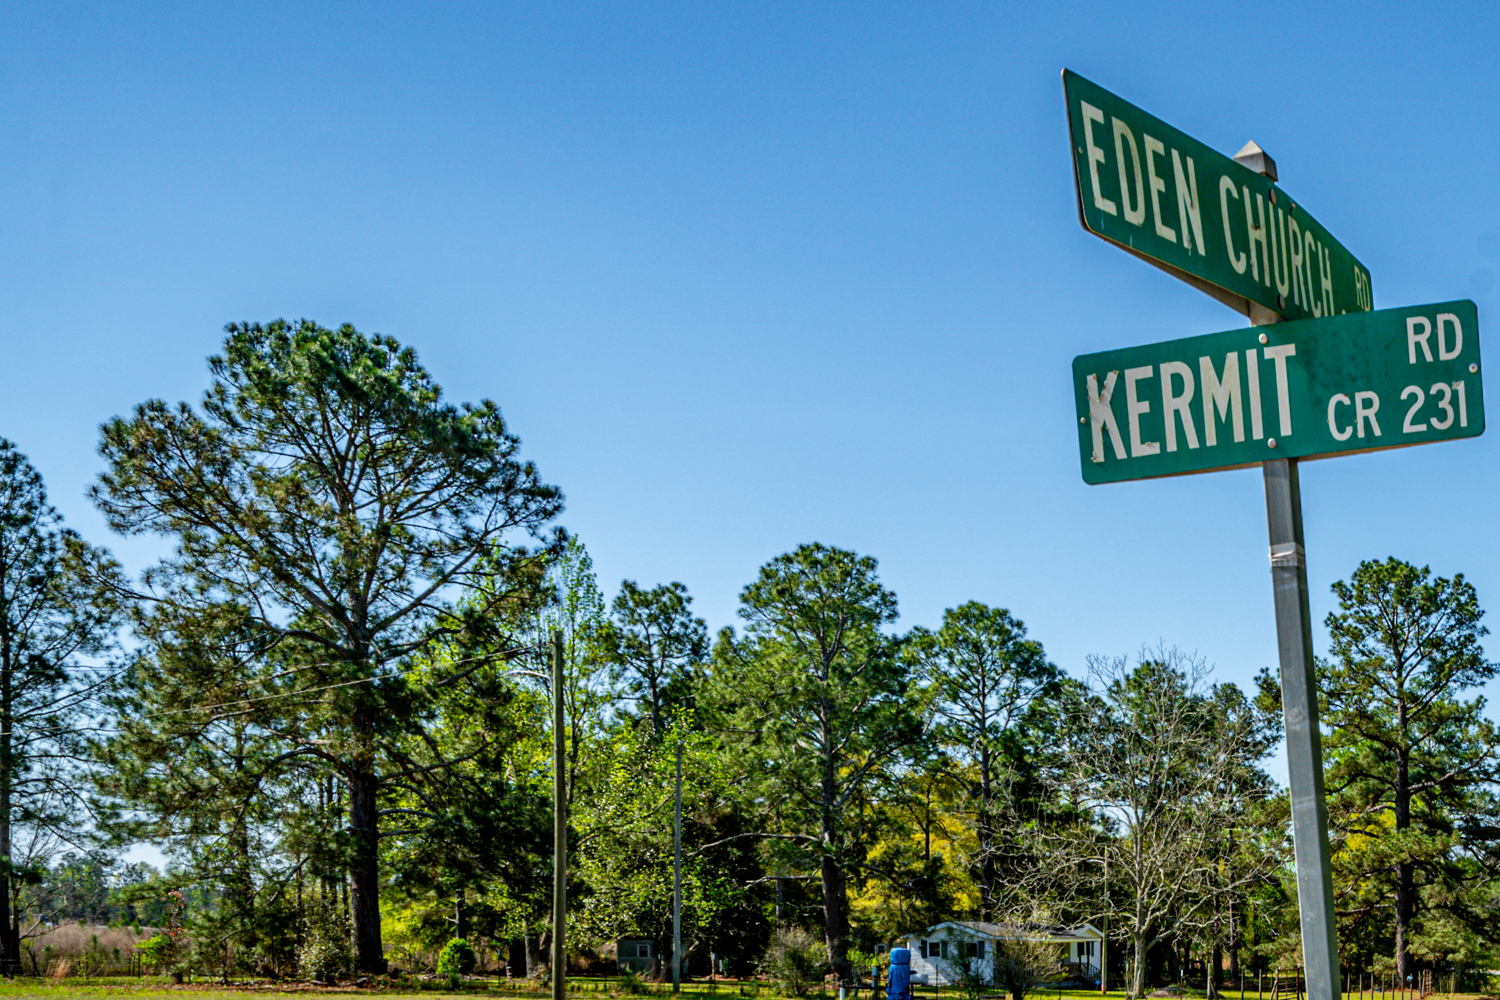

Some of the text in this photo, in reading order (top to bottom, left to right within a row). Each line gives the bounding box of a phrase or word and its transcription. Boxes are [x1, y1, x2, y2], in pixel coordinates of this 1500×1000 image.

[1081, 100, 1370, 318] EDEN CHURCH RD
[1406, 313, 1463, 364] RD
[1087, 344, 1296, 463] KERMIT
[1328, 380, 1468, 441] CR 231
